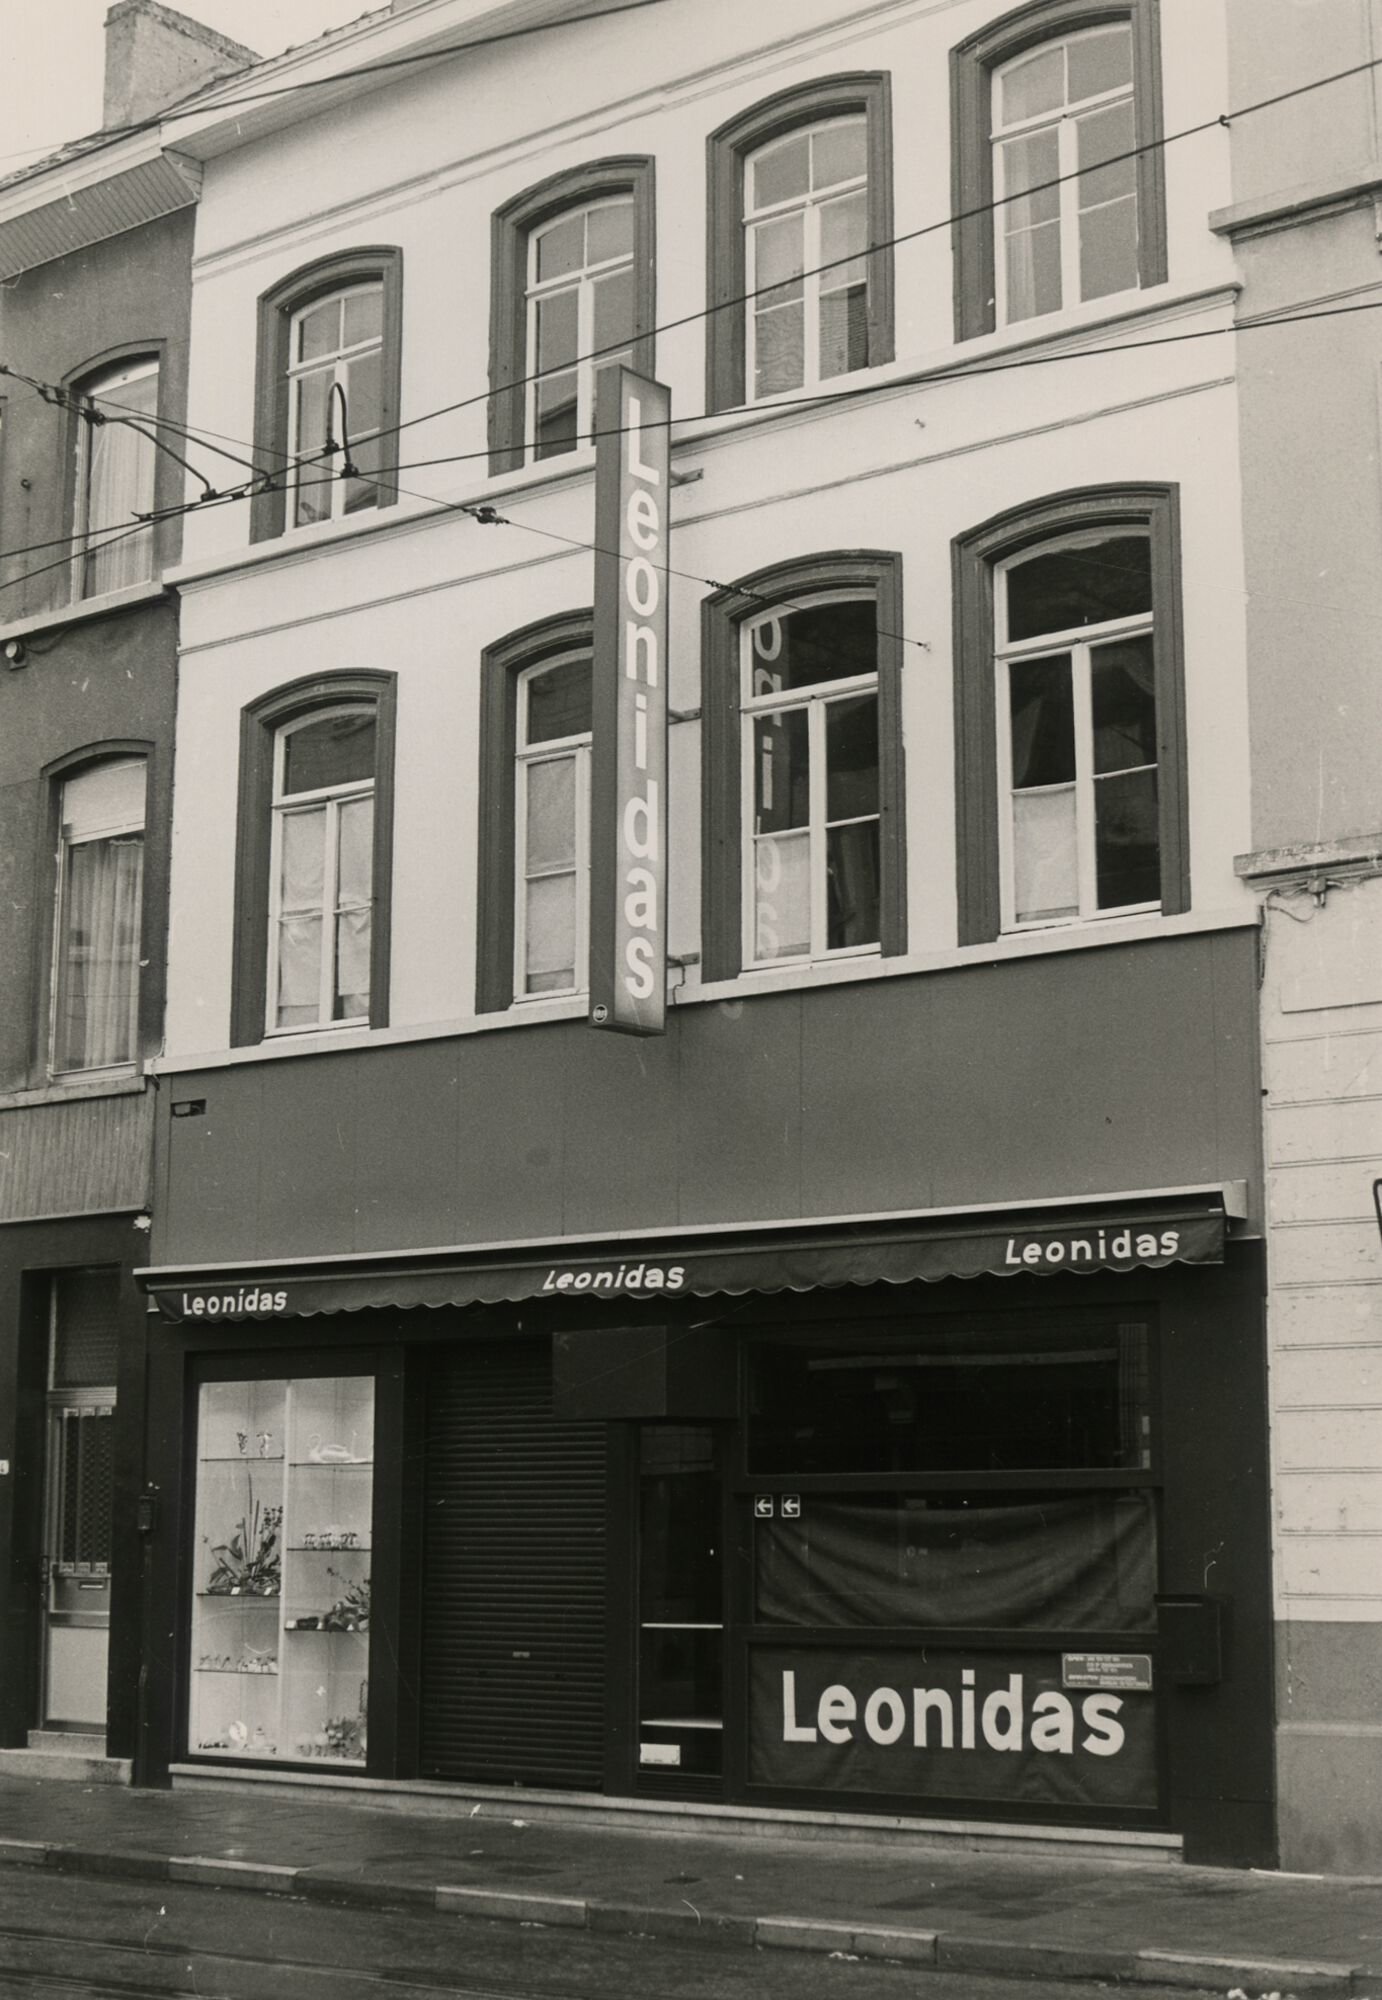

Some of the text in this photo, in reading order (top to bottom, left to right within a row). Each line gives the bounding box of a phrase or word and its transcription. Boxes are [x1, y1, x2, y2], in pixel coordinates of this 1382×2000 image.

[624, 397, 660, 999] Leonidas
[1005, 1229, 1180, 1265] Leonidas
[543, 1264, 686, 1290] Leonidas
[183, 1288, 288, 1315] Leonidas
[782, 1669, 1125, 1756] Leonidas
